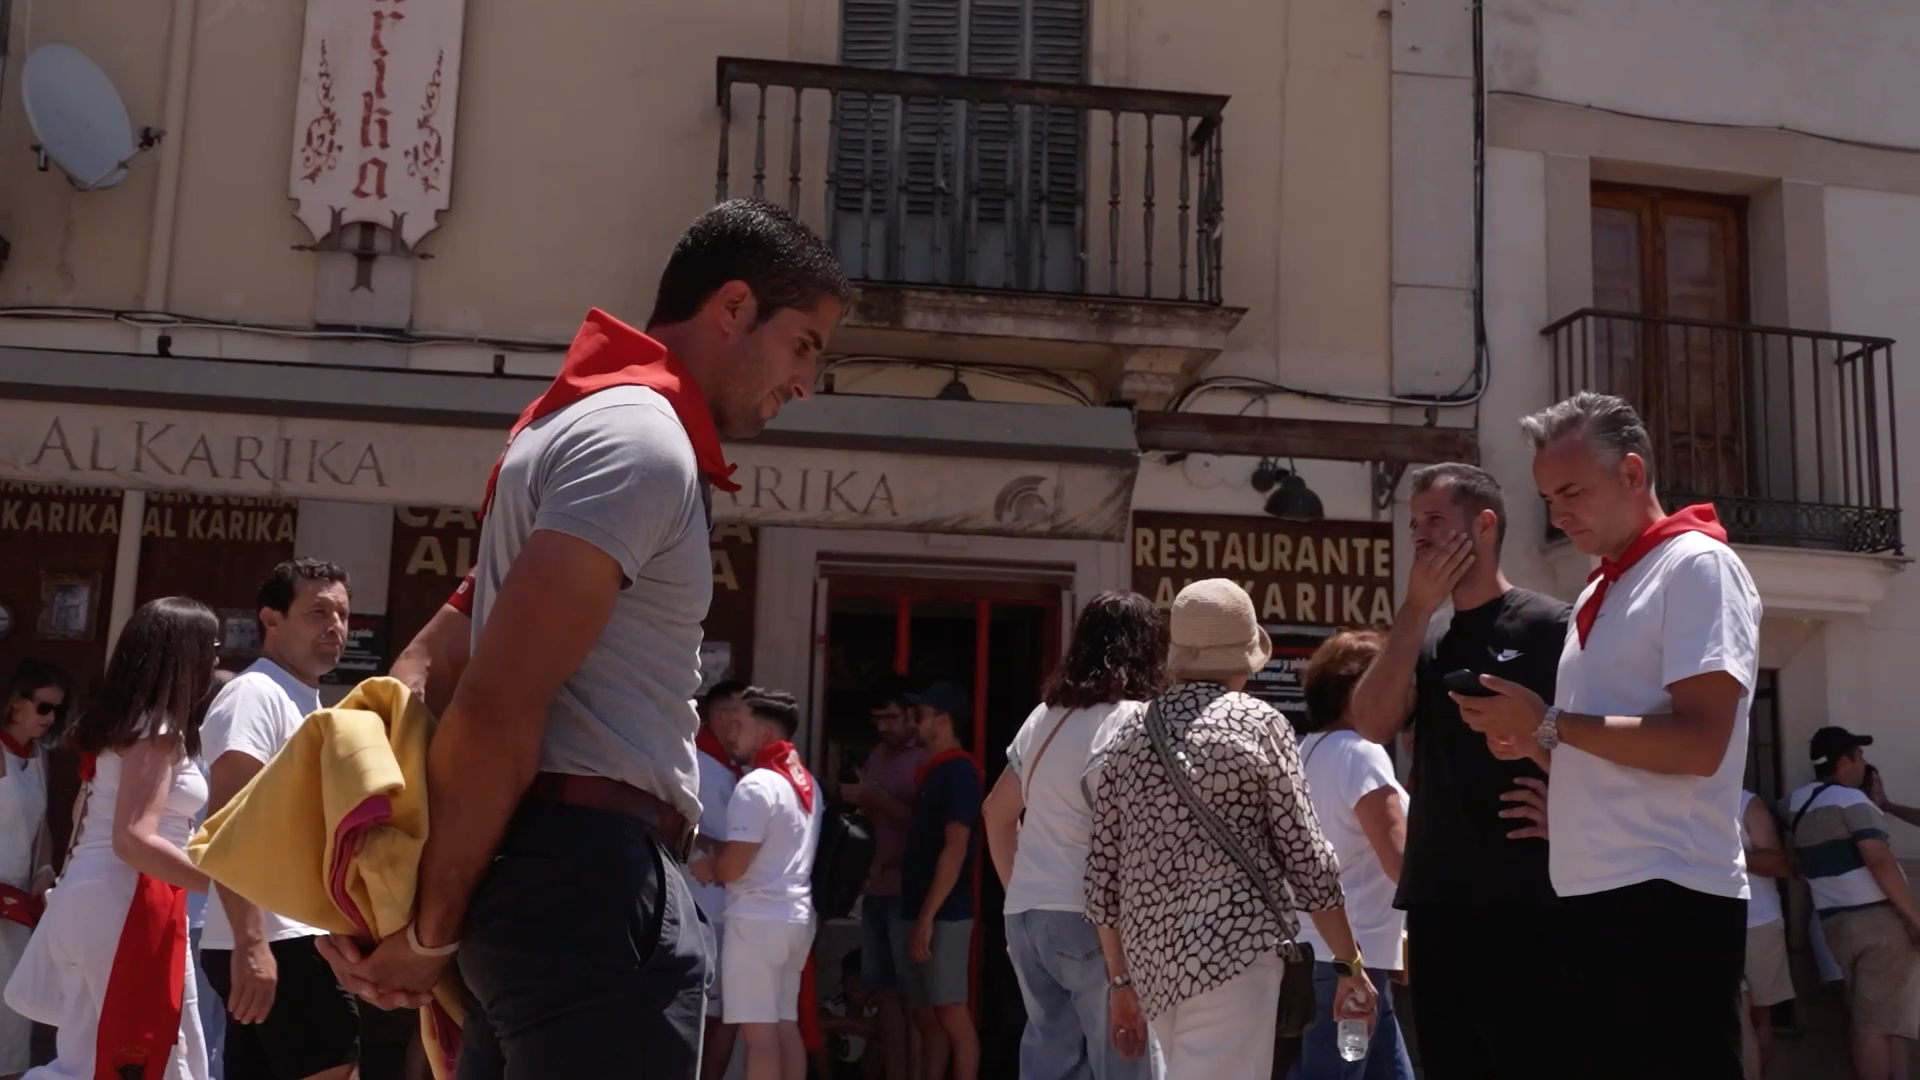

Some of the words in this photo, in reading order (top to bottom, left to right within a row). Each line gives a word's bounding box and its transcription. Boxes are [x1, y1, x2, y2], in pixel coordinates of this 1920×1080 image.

[1, 499, 119, 535] KARIKA
[142, 507, 177, 539] AL
[187, 508, 295, 543] KARIKA
[1134, 527, 1391, 577] RESTAURANTE
[1237, 579, 1394, 626] ARIKA
